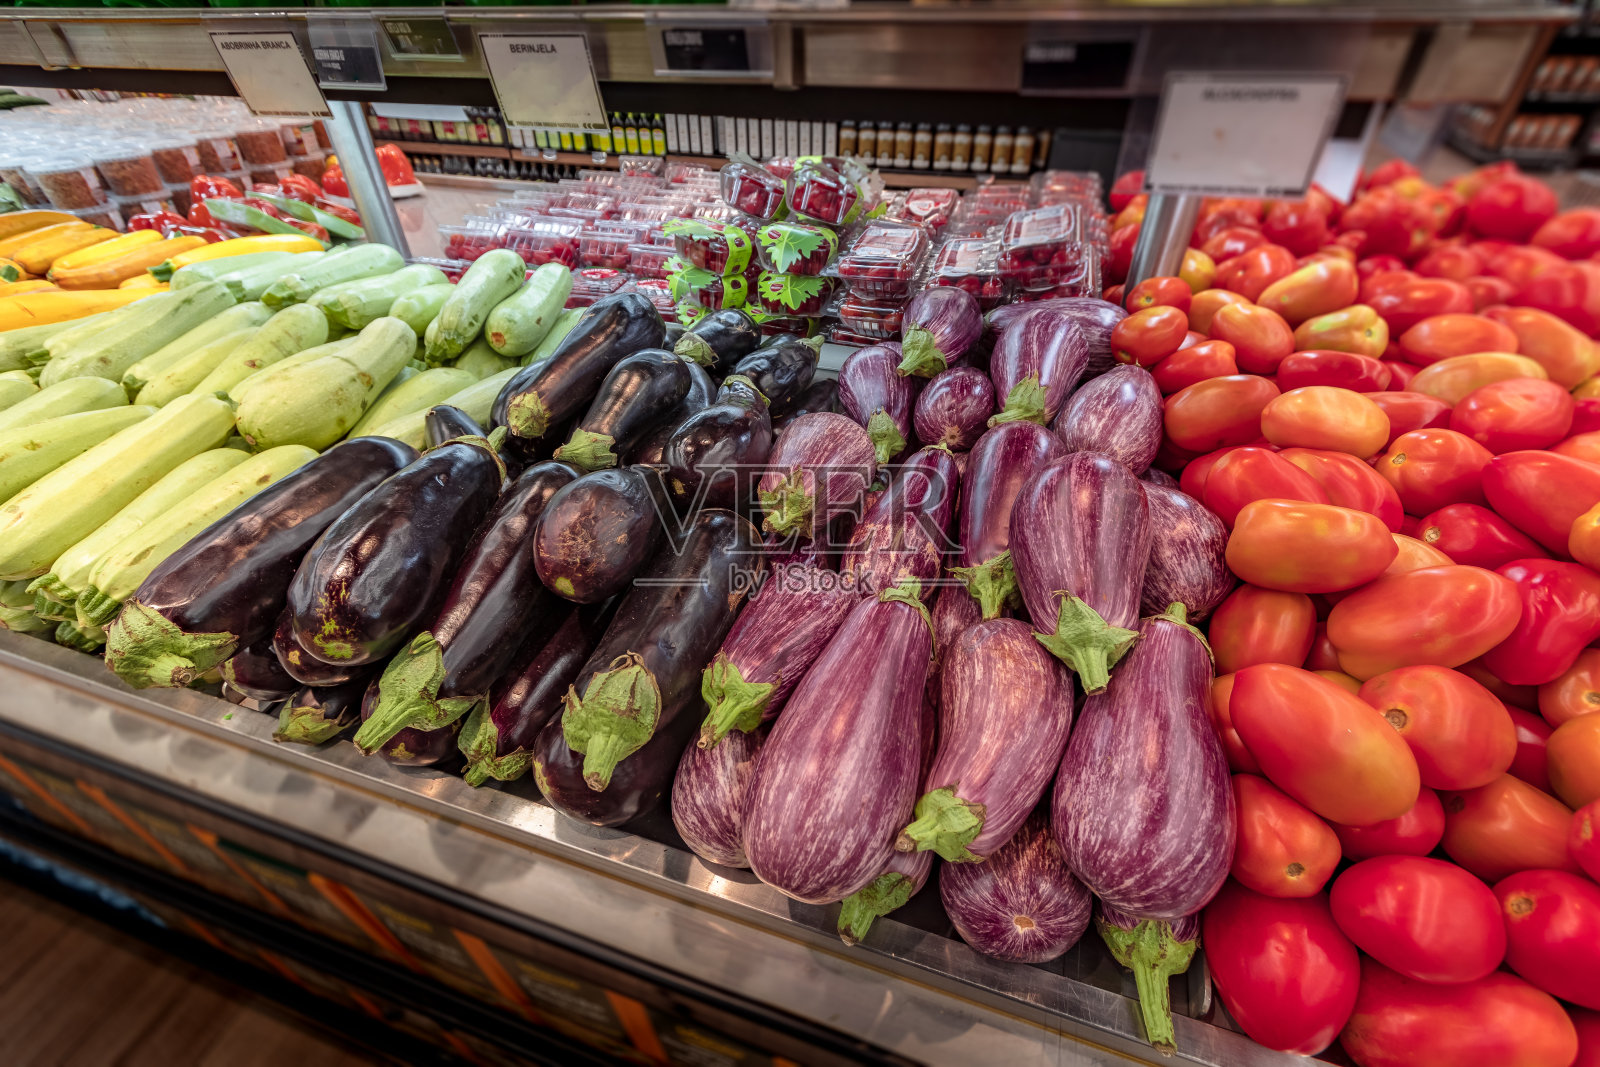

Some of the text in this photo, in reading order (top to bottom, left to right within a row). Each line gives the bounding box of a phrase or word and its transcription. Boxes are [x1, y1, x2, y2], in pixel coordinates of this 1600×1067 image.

[221, 41, 291, 50] ABOBRINHA BRANCA
[509, 44, 557, 53] BERINJELA
